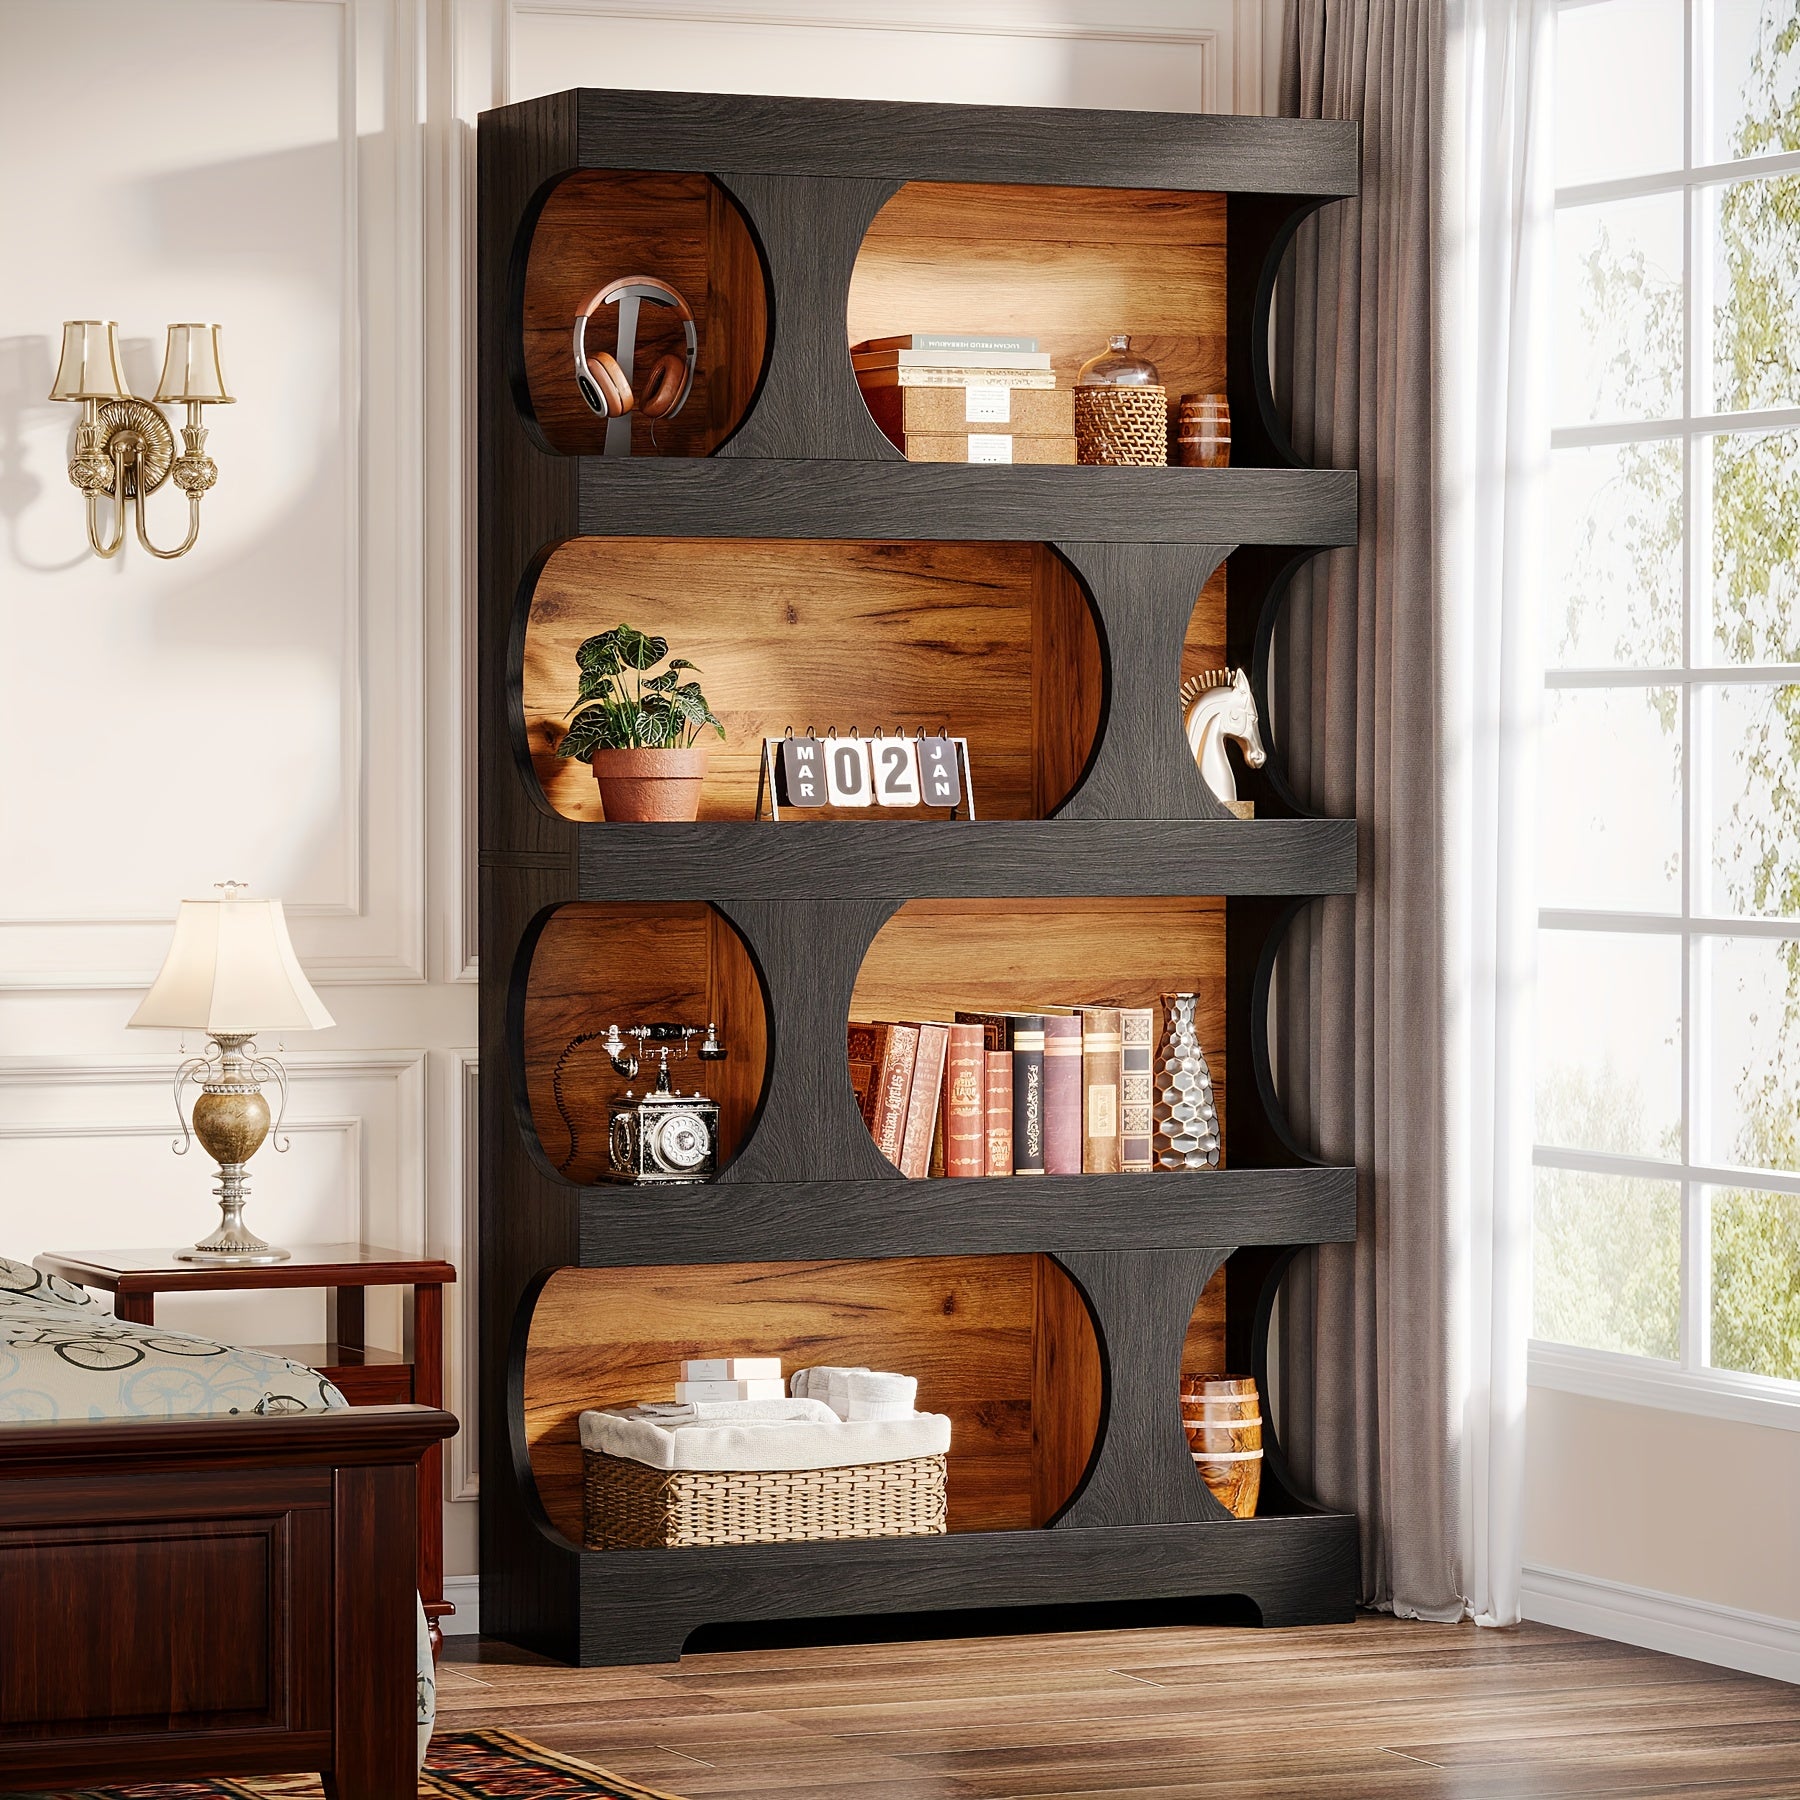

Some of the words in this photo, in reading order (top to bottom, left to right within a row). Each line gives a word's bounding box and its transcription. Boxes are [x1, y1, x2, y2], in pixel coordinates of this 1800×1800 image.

[928, 340, 969, 348] HERBARIUM
[969, 341, 993, 349] FREUD
[994, 342, 1020, 350] LUCIAN
[796, 746, 815, 798] MAR
[930, 746, 951, 797] JAN
[878, 1112, 898, 1162] hristian
